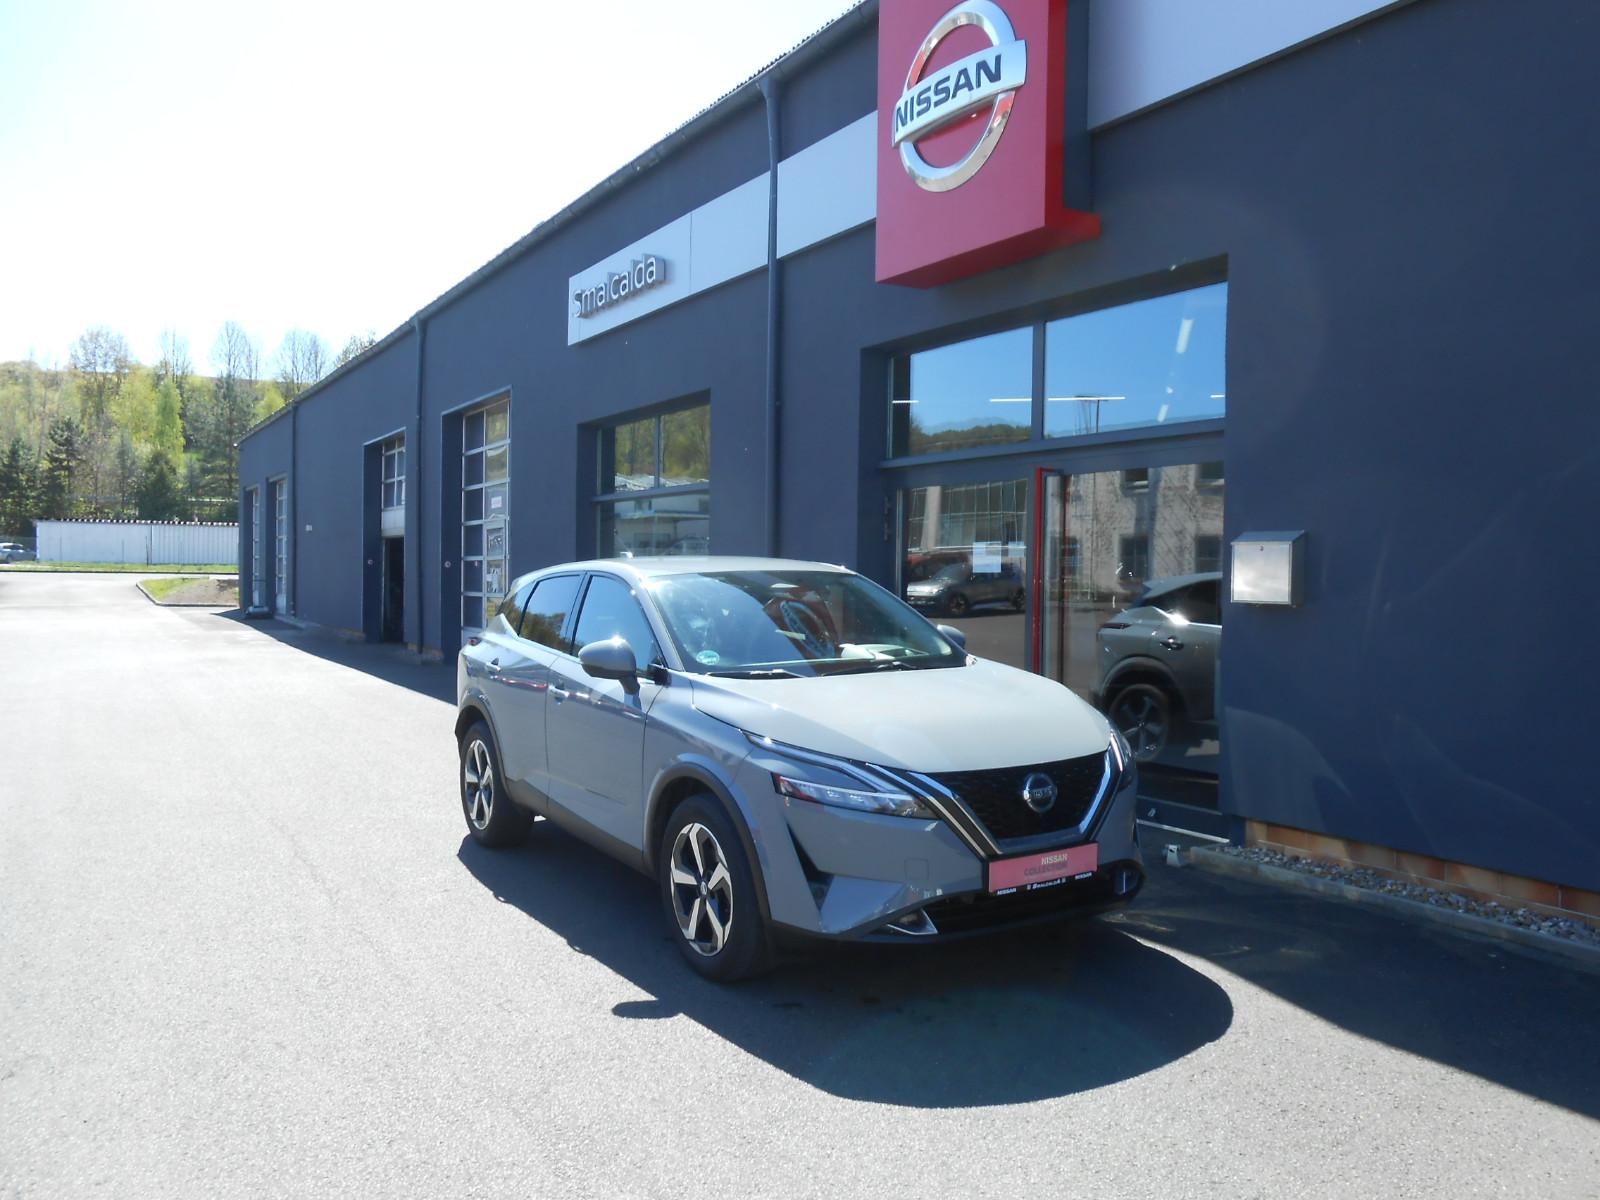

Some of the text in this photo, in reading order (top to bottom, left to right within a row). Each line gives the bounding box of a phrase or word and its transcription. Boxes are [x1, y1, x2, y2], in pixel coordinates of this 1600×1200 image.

[895, 54, 1002, 133] NISSAN
[573, 254, 658, 318] Smalcalda
[1041, 853, 1068, 865] NISSAN
